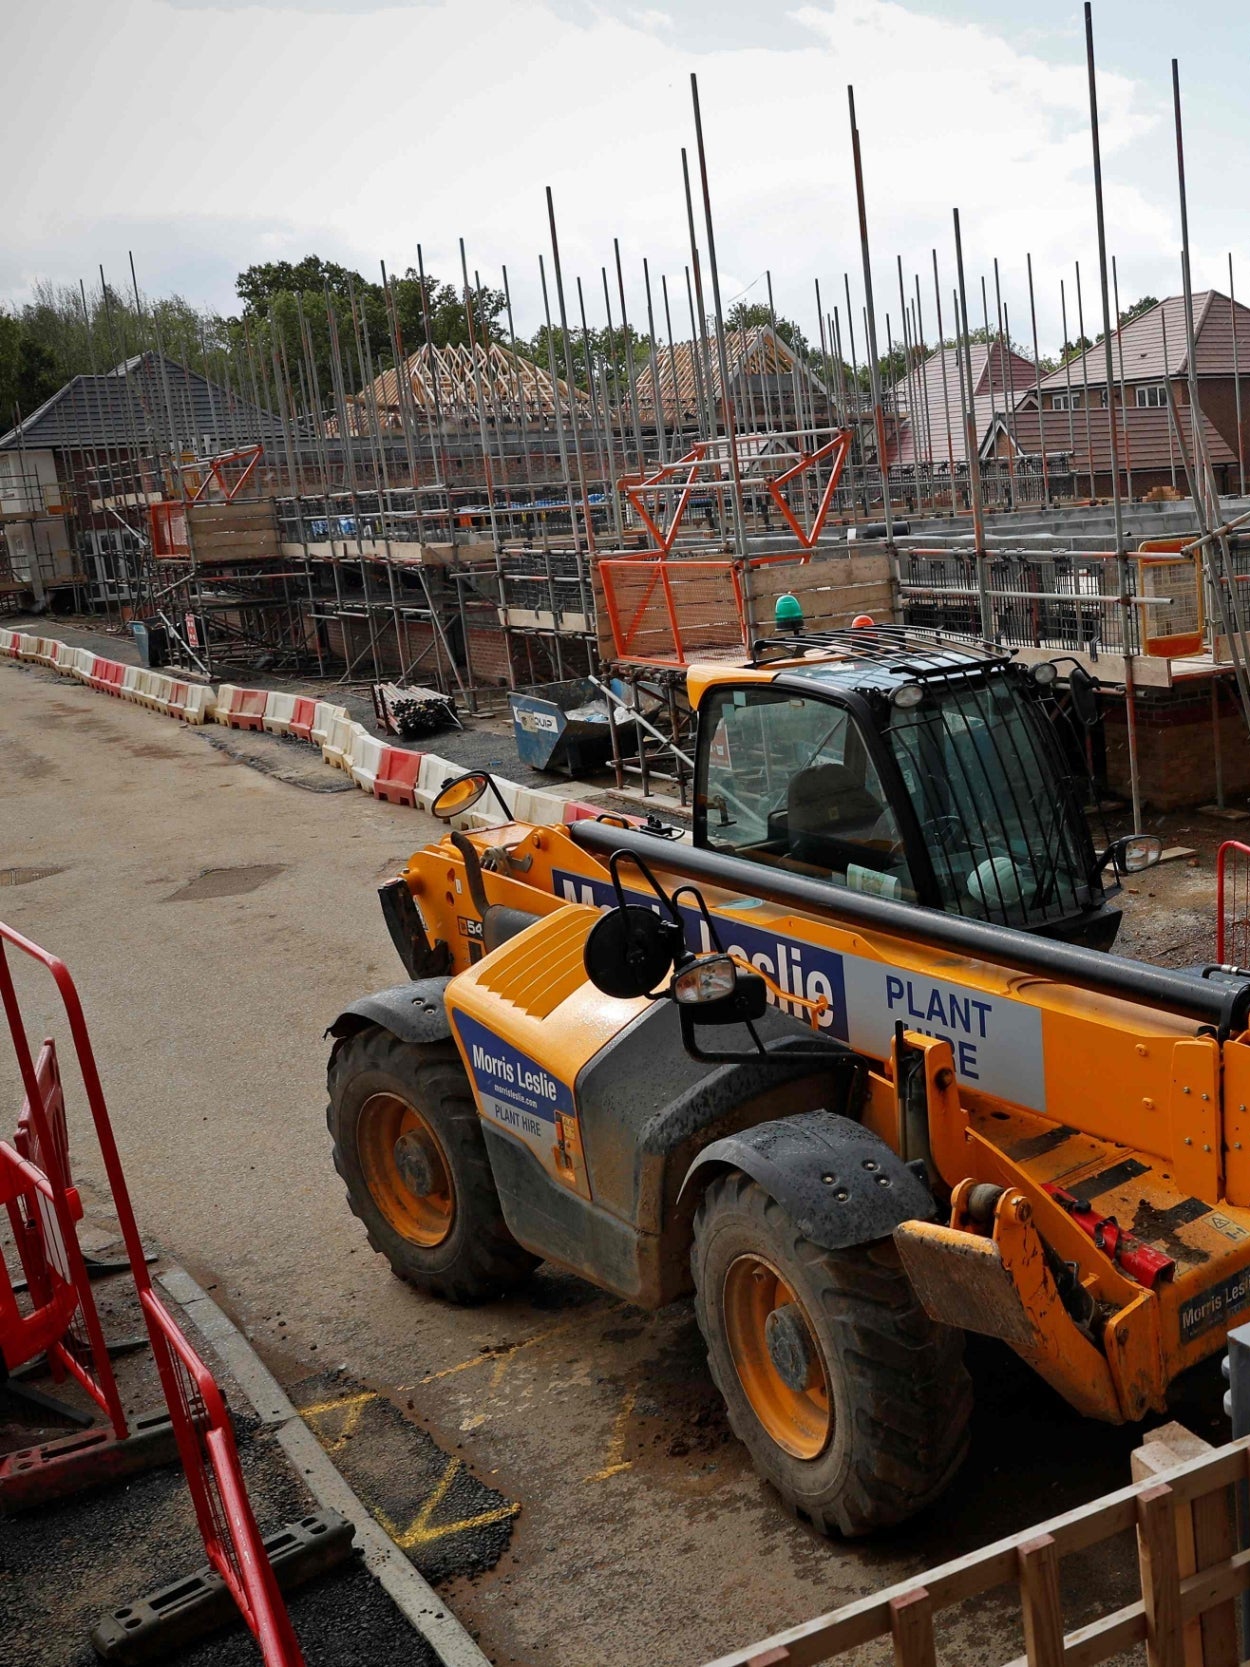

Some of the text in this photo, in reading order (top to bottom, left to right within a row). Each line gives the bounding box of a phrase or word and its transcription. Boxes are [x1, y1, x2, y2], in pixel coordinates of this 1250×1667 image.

[886, 974, 993, 1039] PLANT
[473, 1044, 558, 1102] Morris Leslie
[494, 1083, 538, 1110] morrisleslie.com
[495, 1103, 521, 1128] PLANT
[522, 1115, 542, 1138] HIRE
[1182, 1295, 1222, 1329] Morris
